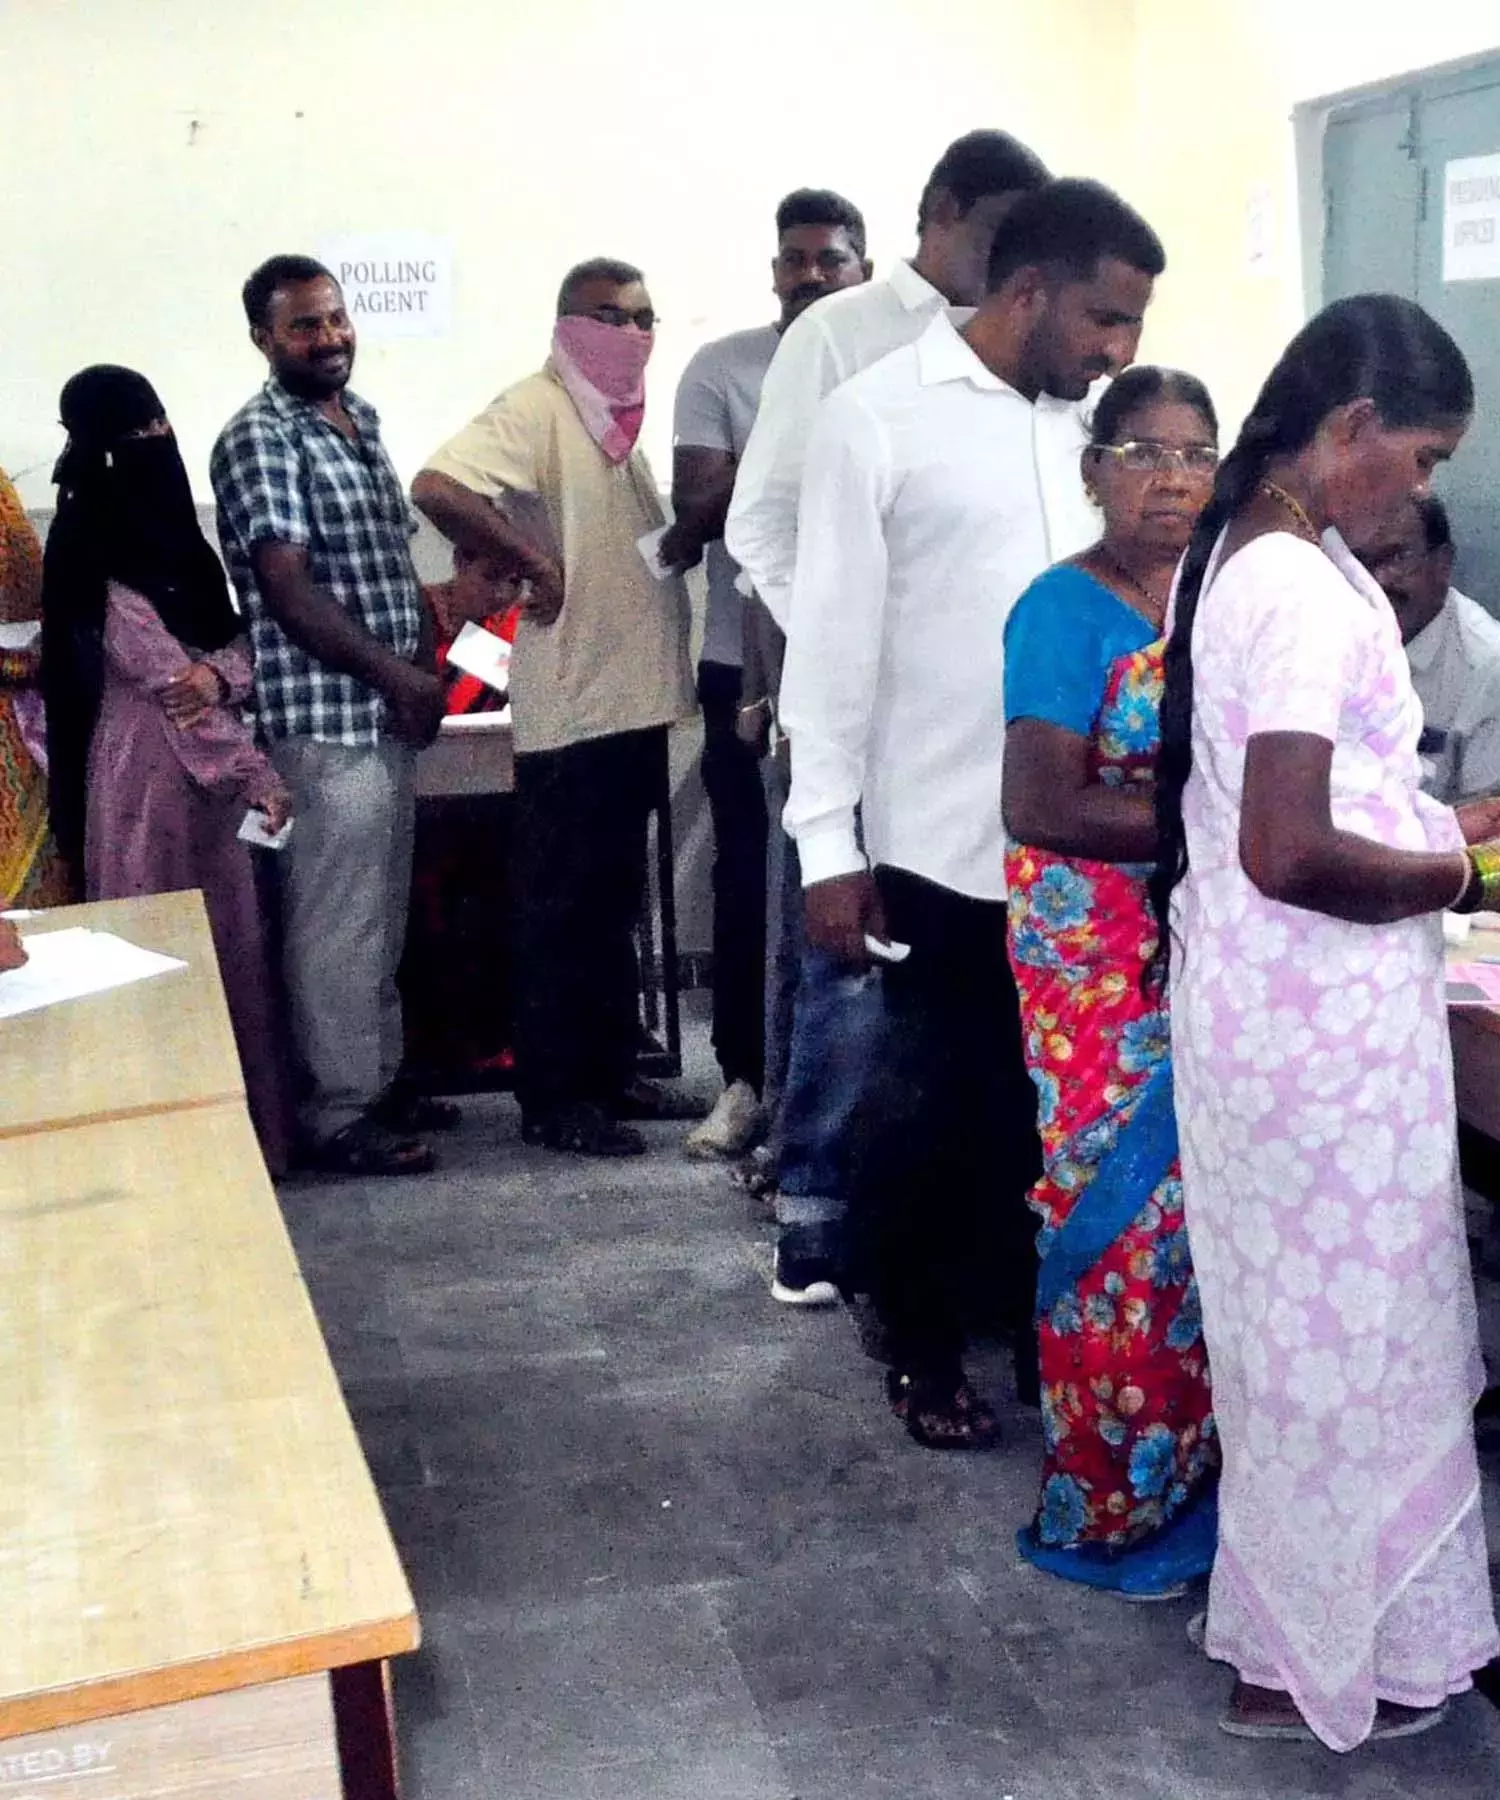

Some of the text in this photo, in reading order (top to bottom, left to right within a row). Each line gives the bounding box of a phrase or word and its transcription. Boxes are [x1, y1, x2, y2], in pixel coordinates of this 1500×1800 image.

[340, 260, 436, 284] POLLING
[352, 289, 428, 313] AGENT
[72, 1741, 112, 1770] BY
